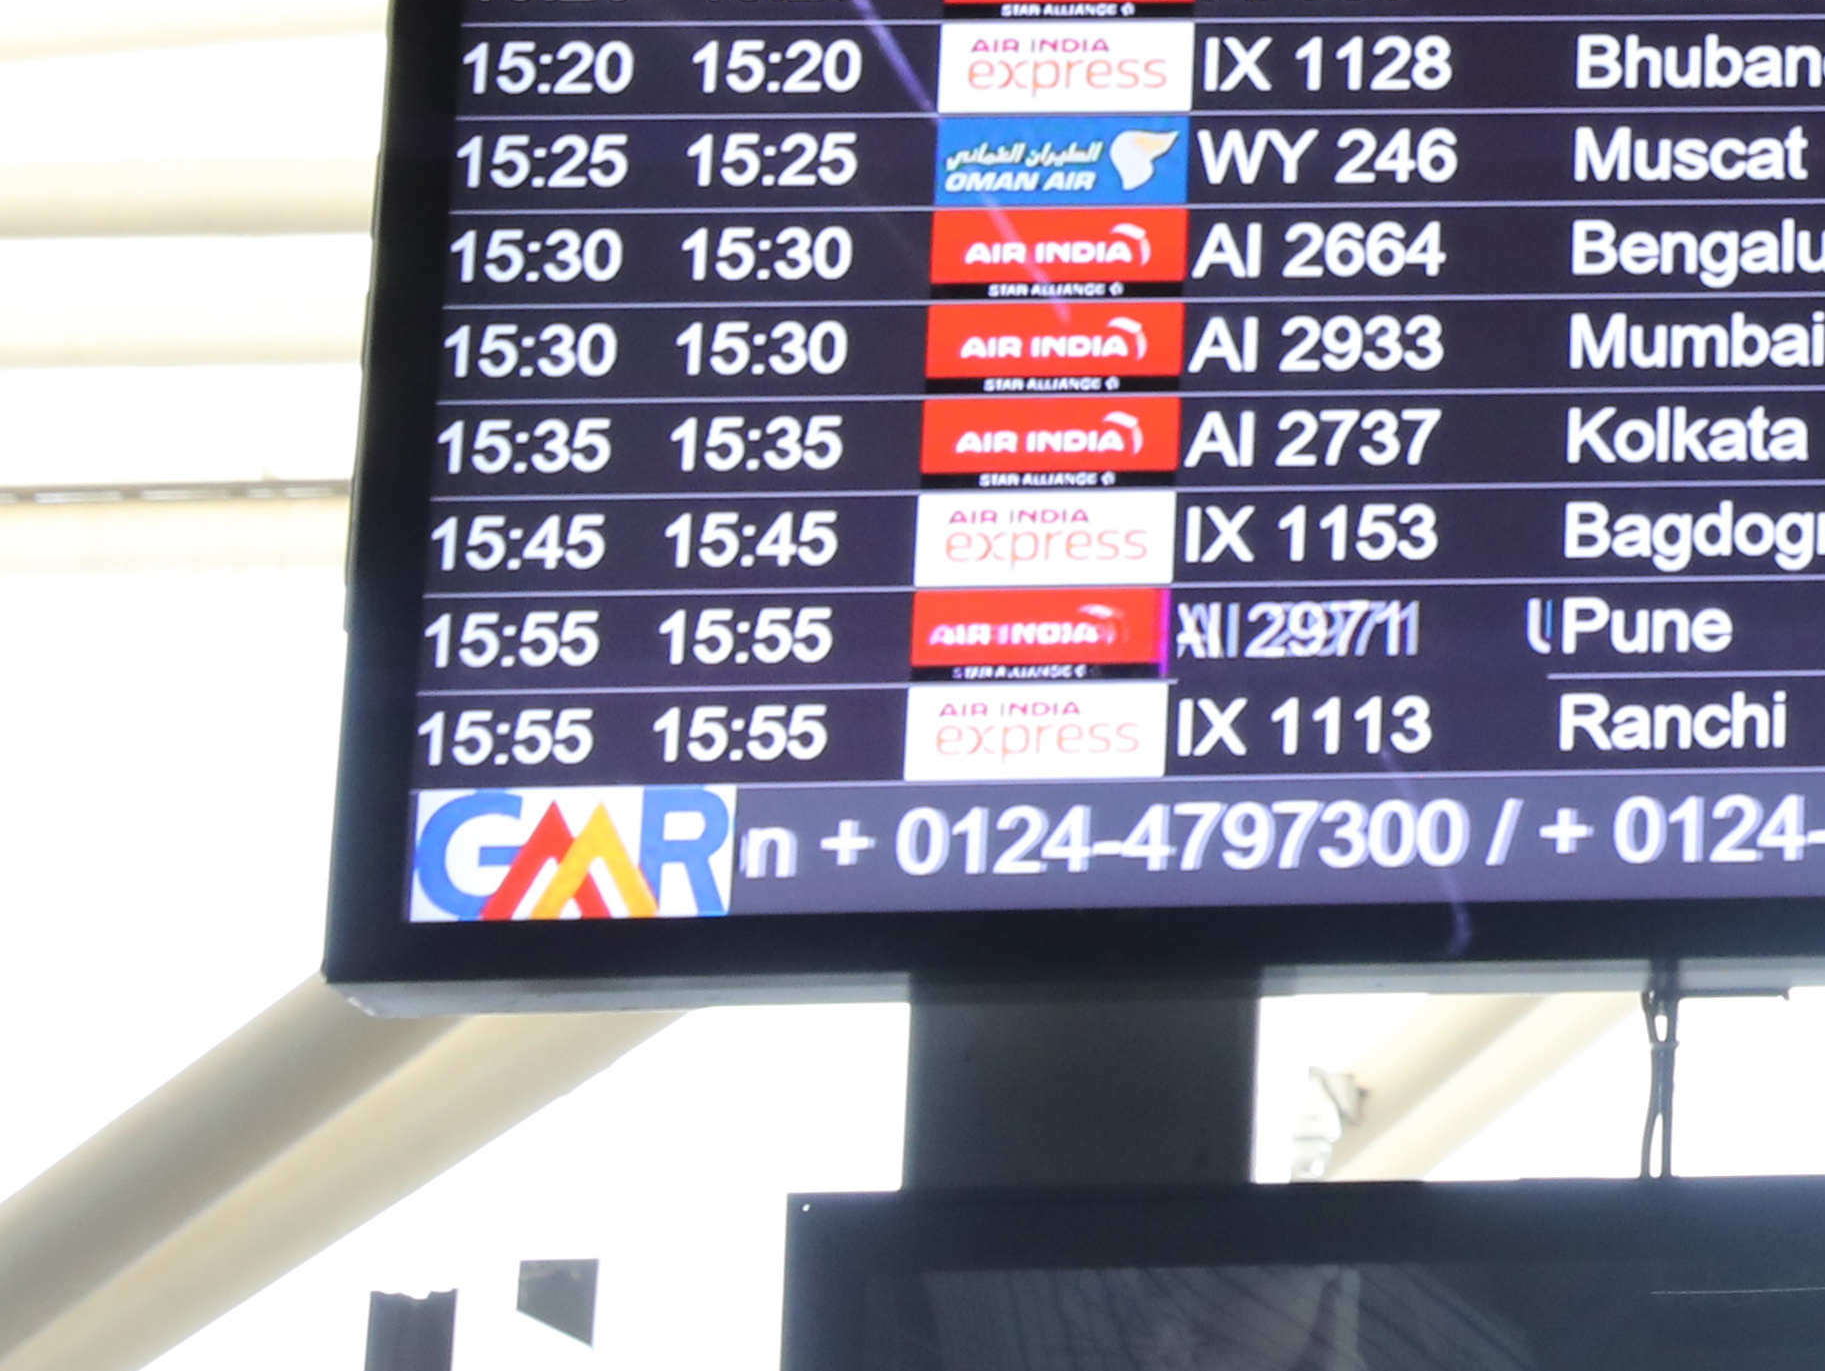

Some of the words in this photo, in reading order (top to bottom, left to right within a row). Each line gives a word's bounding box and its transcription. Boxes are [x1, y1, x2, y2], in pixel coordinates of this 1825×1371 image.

[457, 134, 628, 187] 15:25
[687, 132, 857, 186] 15:25
[1197, 129, 1318, 184] WY
[1335, 128, 1457, 183] 246
[1574, 126, 1808, 181] Muscat
[945, 172, 1039, 191] OMAN
[1043, 171, 1096, 190] AIR
[945, 530, 1147, 569] express
[896, 798, 1470, 875] 0124-4797300
